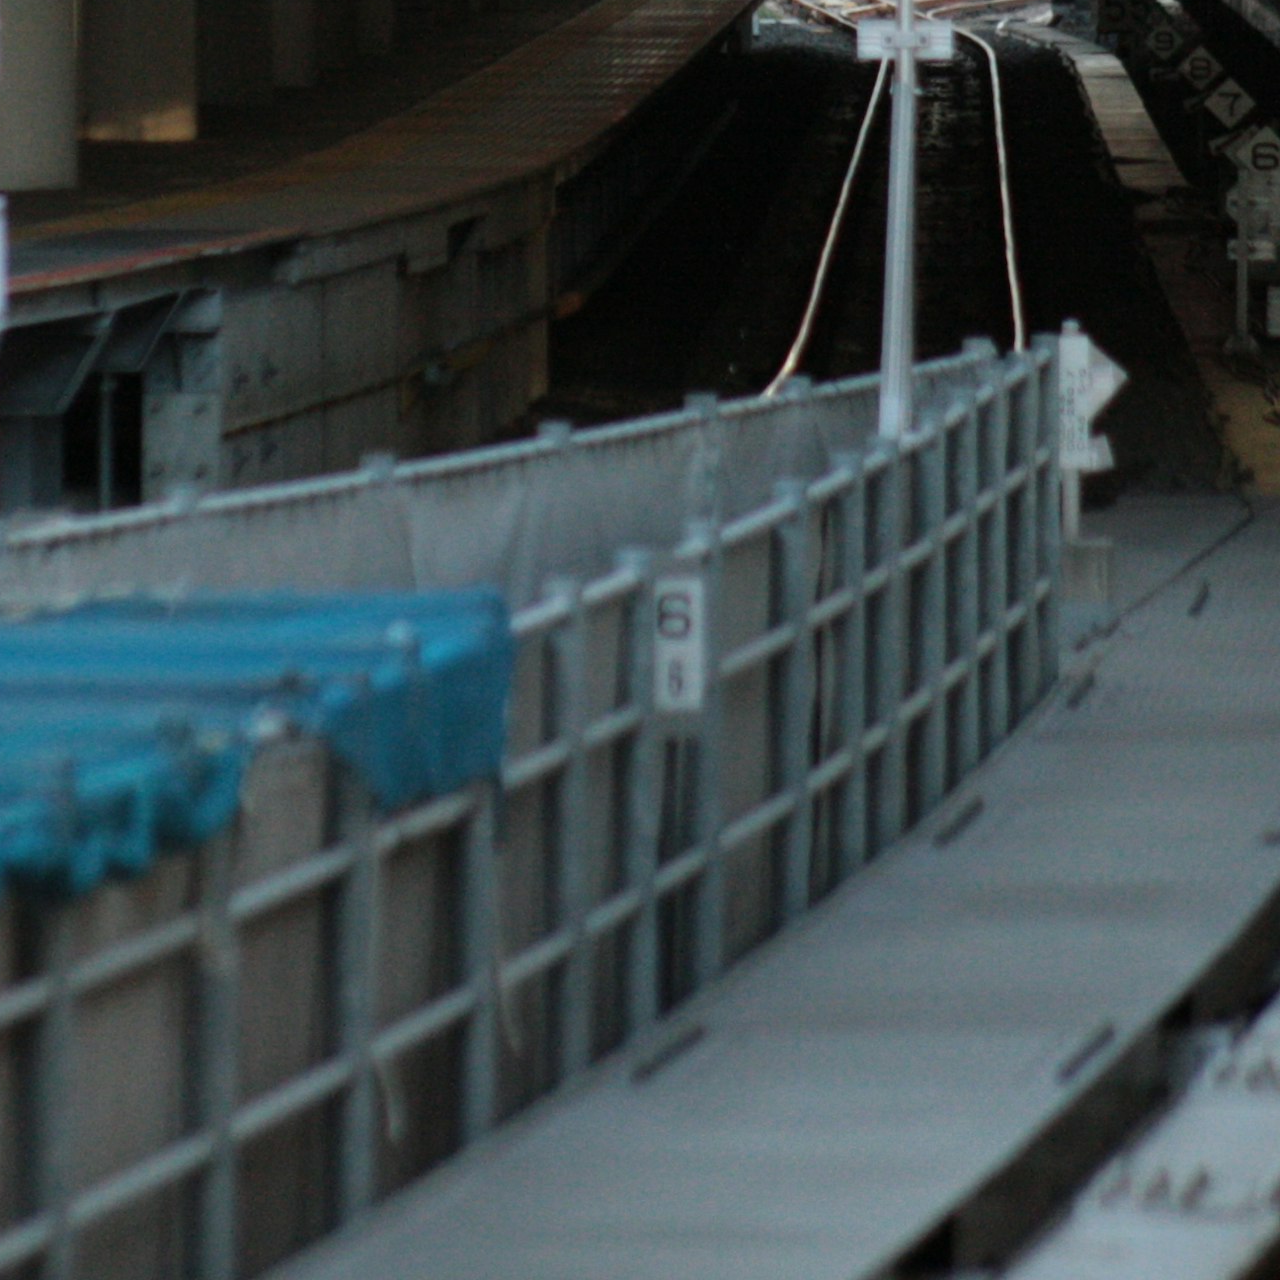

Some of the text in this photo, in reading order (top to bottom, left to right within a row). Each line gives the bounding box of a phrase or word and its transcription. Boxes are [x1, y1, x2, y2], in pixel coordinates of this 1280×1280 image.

[1217, 92, 1240, 118] 7
[1250, 141, 1280, 171] 6
[657, 592, 692, 640] 6
